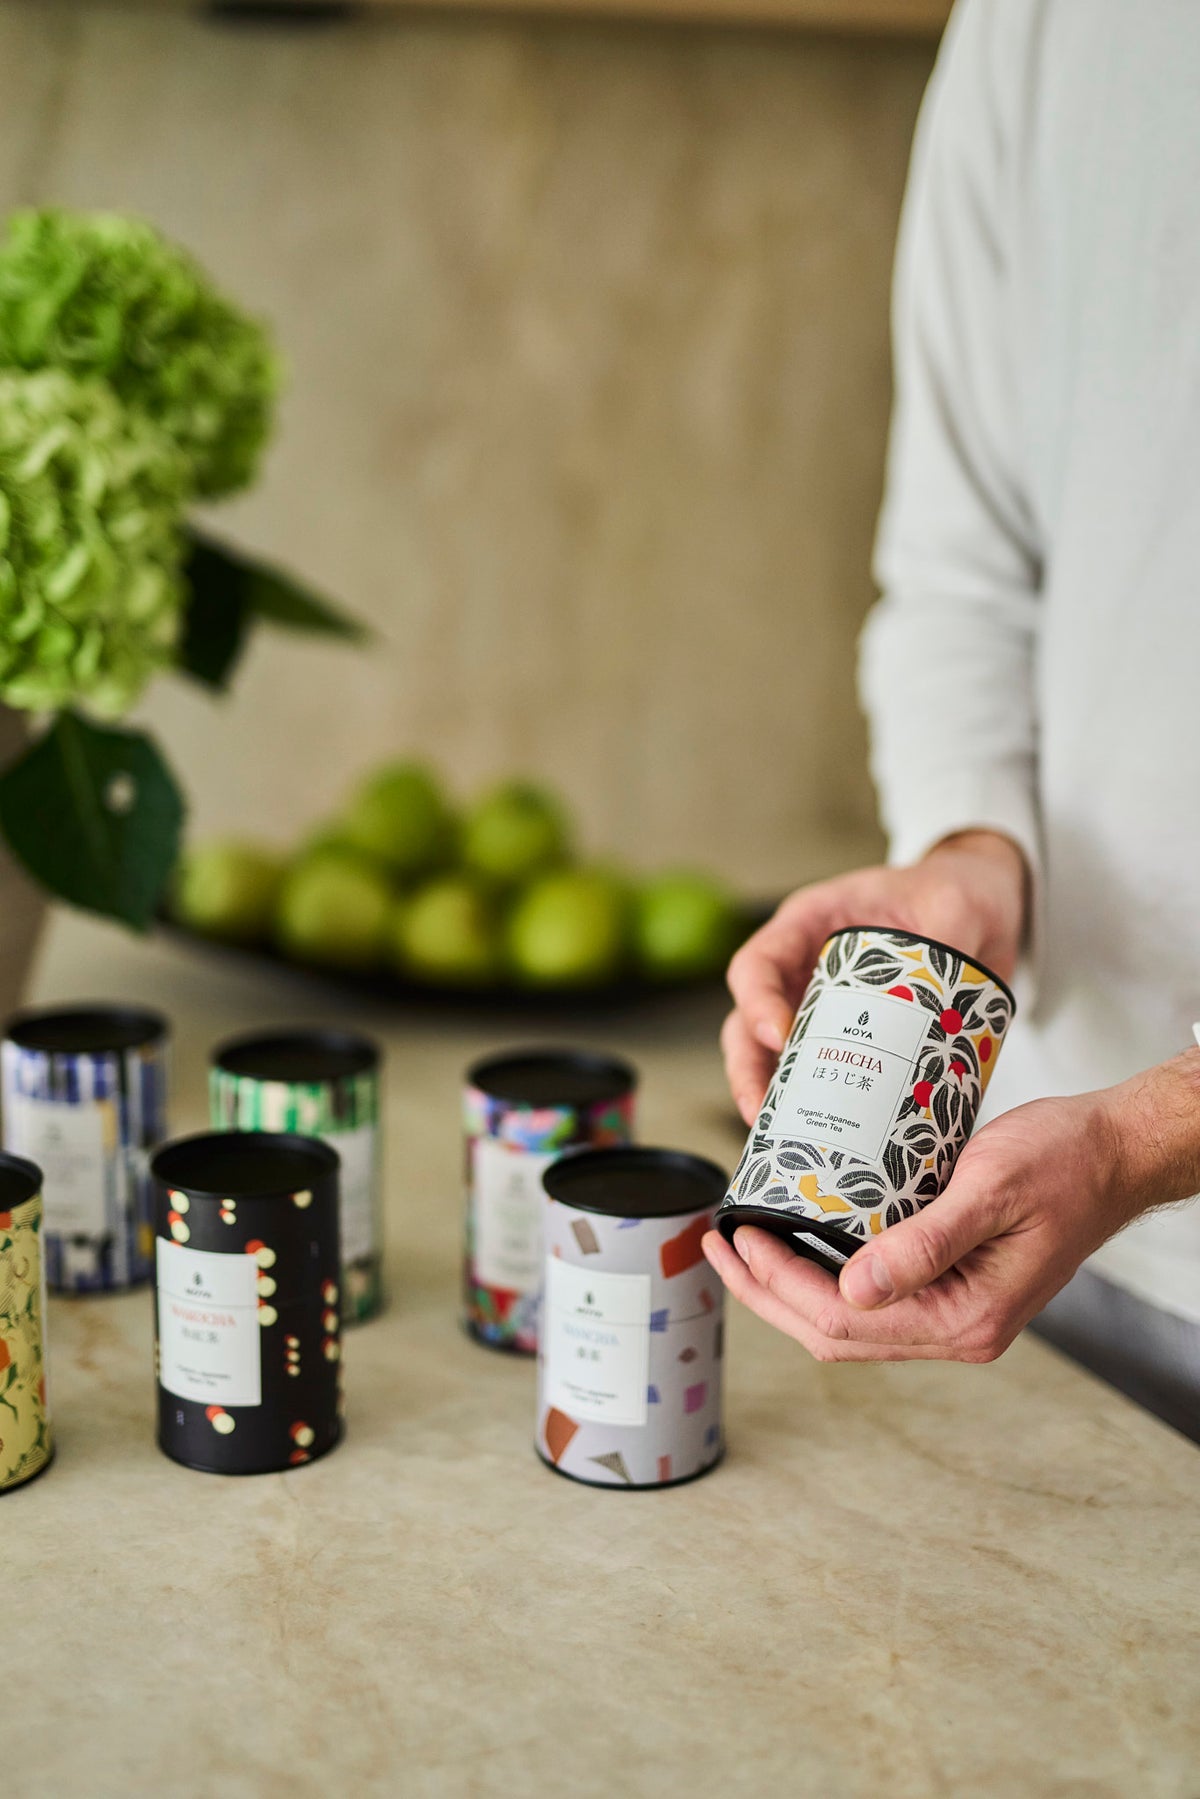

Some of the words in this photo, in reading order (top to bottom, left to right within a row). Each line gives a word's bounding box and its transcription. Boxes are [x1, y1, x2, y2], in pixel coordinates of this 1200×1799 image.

[843, 1027, 873, 1039] MOYA
[817, 1047, 882, 1073] HOJICHA
[812, 1066, 874, 1091] ほうじ茶
[797, 1107, 824, 1118] Organic
[824, 1113, 861, 1129] Japanese
[805, 1118, 828, 1129] Green
[829, 1123, 843, 1133] Tea
